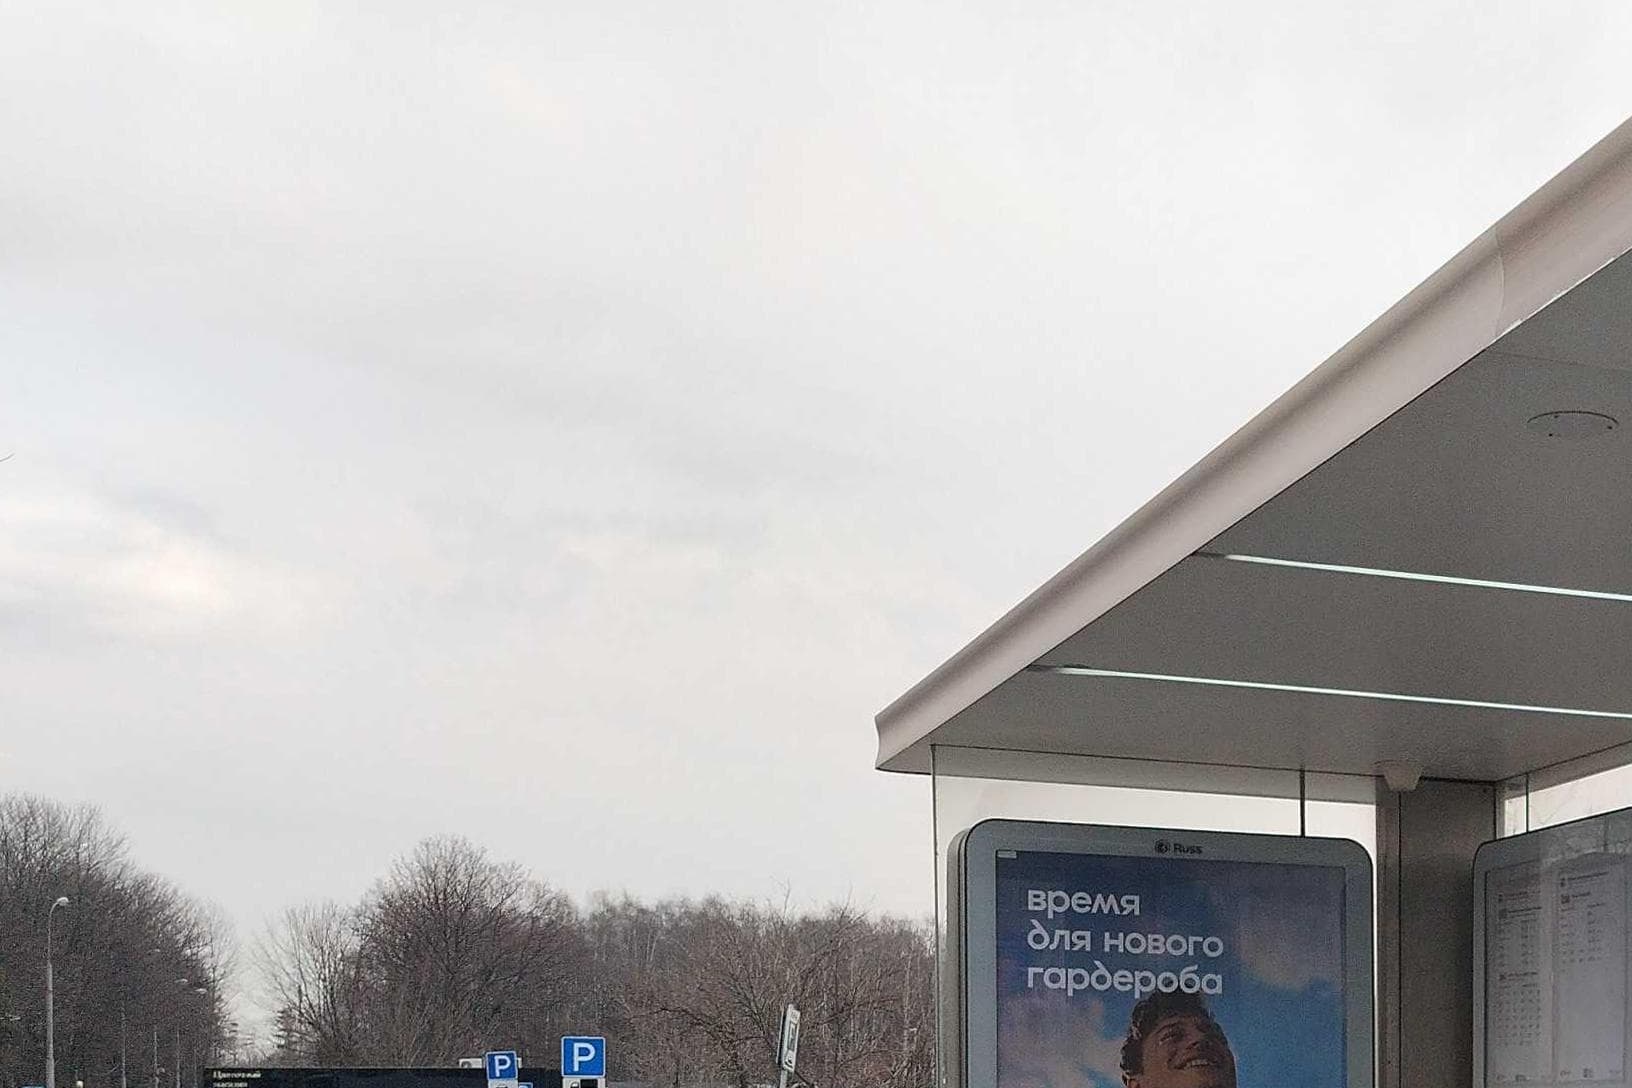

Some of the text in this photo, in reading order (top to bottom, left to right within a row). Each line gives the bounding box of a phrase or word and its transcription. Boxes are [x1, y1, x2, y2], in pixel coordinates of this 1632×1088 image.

[1173, 843, 1203, 855] Russ
[1027, 888, 1141, 919] время
[1027, 919, 1225, 958] для нового
[1027, 960, 1223, 999] гардероба
[494, 1055, 512, 1078] P
[572, 1042, 596, 1072] P
